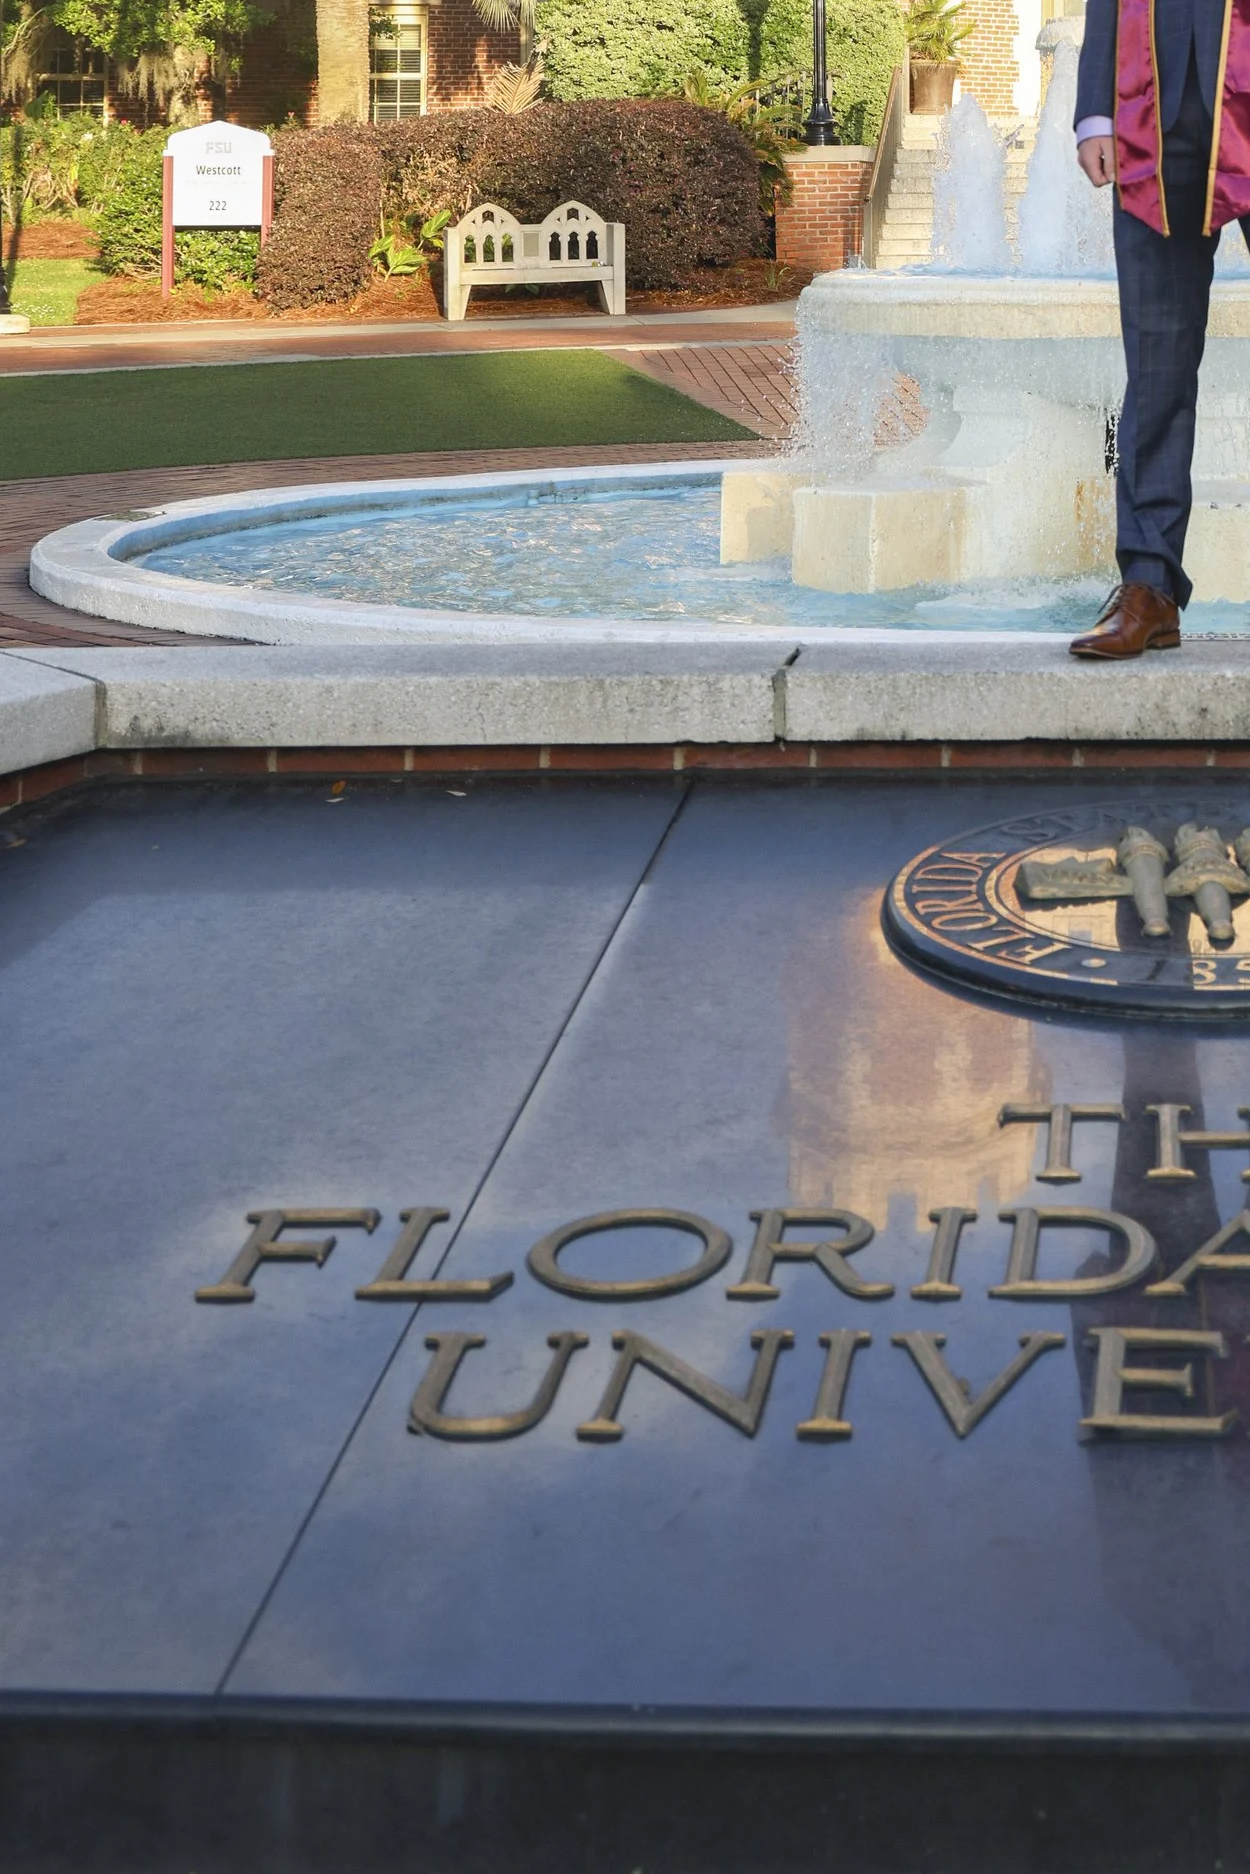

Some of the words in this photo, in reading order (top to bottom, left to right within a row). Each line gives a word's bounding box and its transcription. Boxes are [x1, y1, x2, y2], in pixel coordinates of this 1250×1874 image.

[205, 141, 232, 154] FSU
[195, 165, 242, 176] Westcott
[208, 200, 228, 211] 222
[911, 850, 1073, 967] FLORIDA
